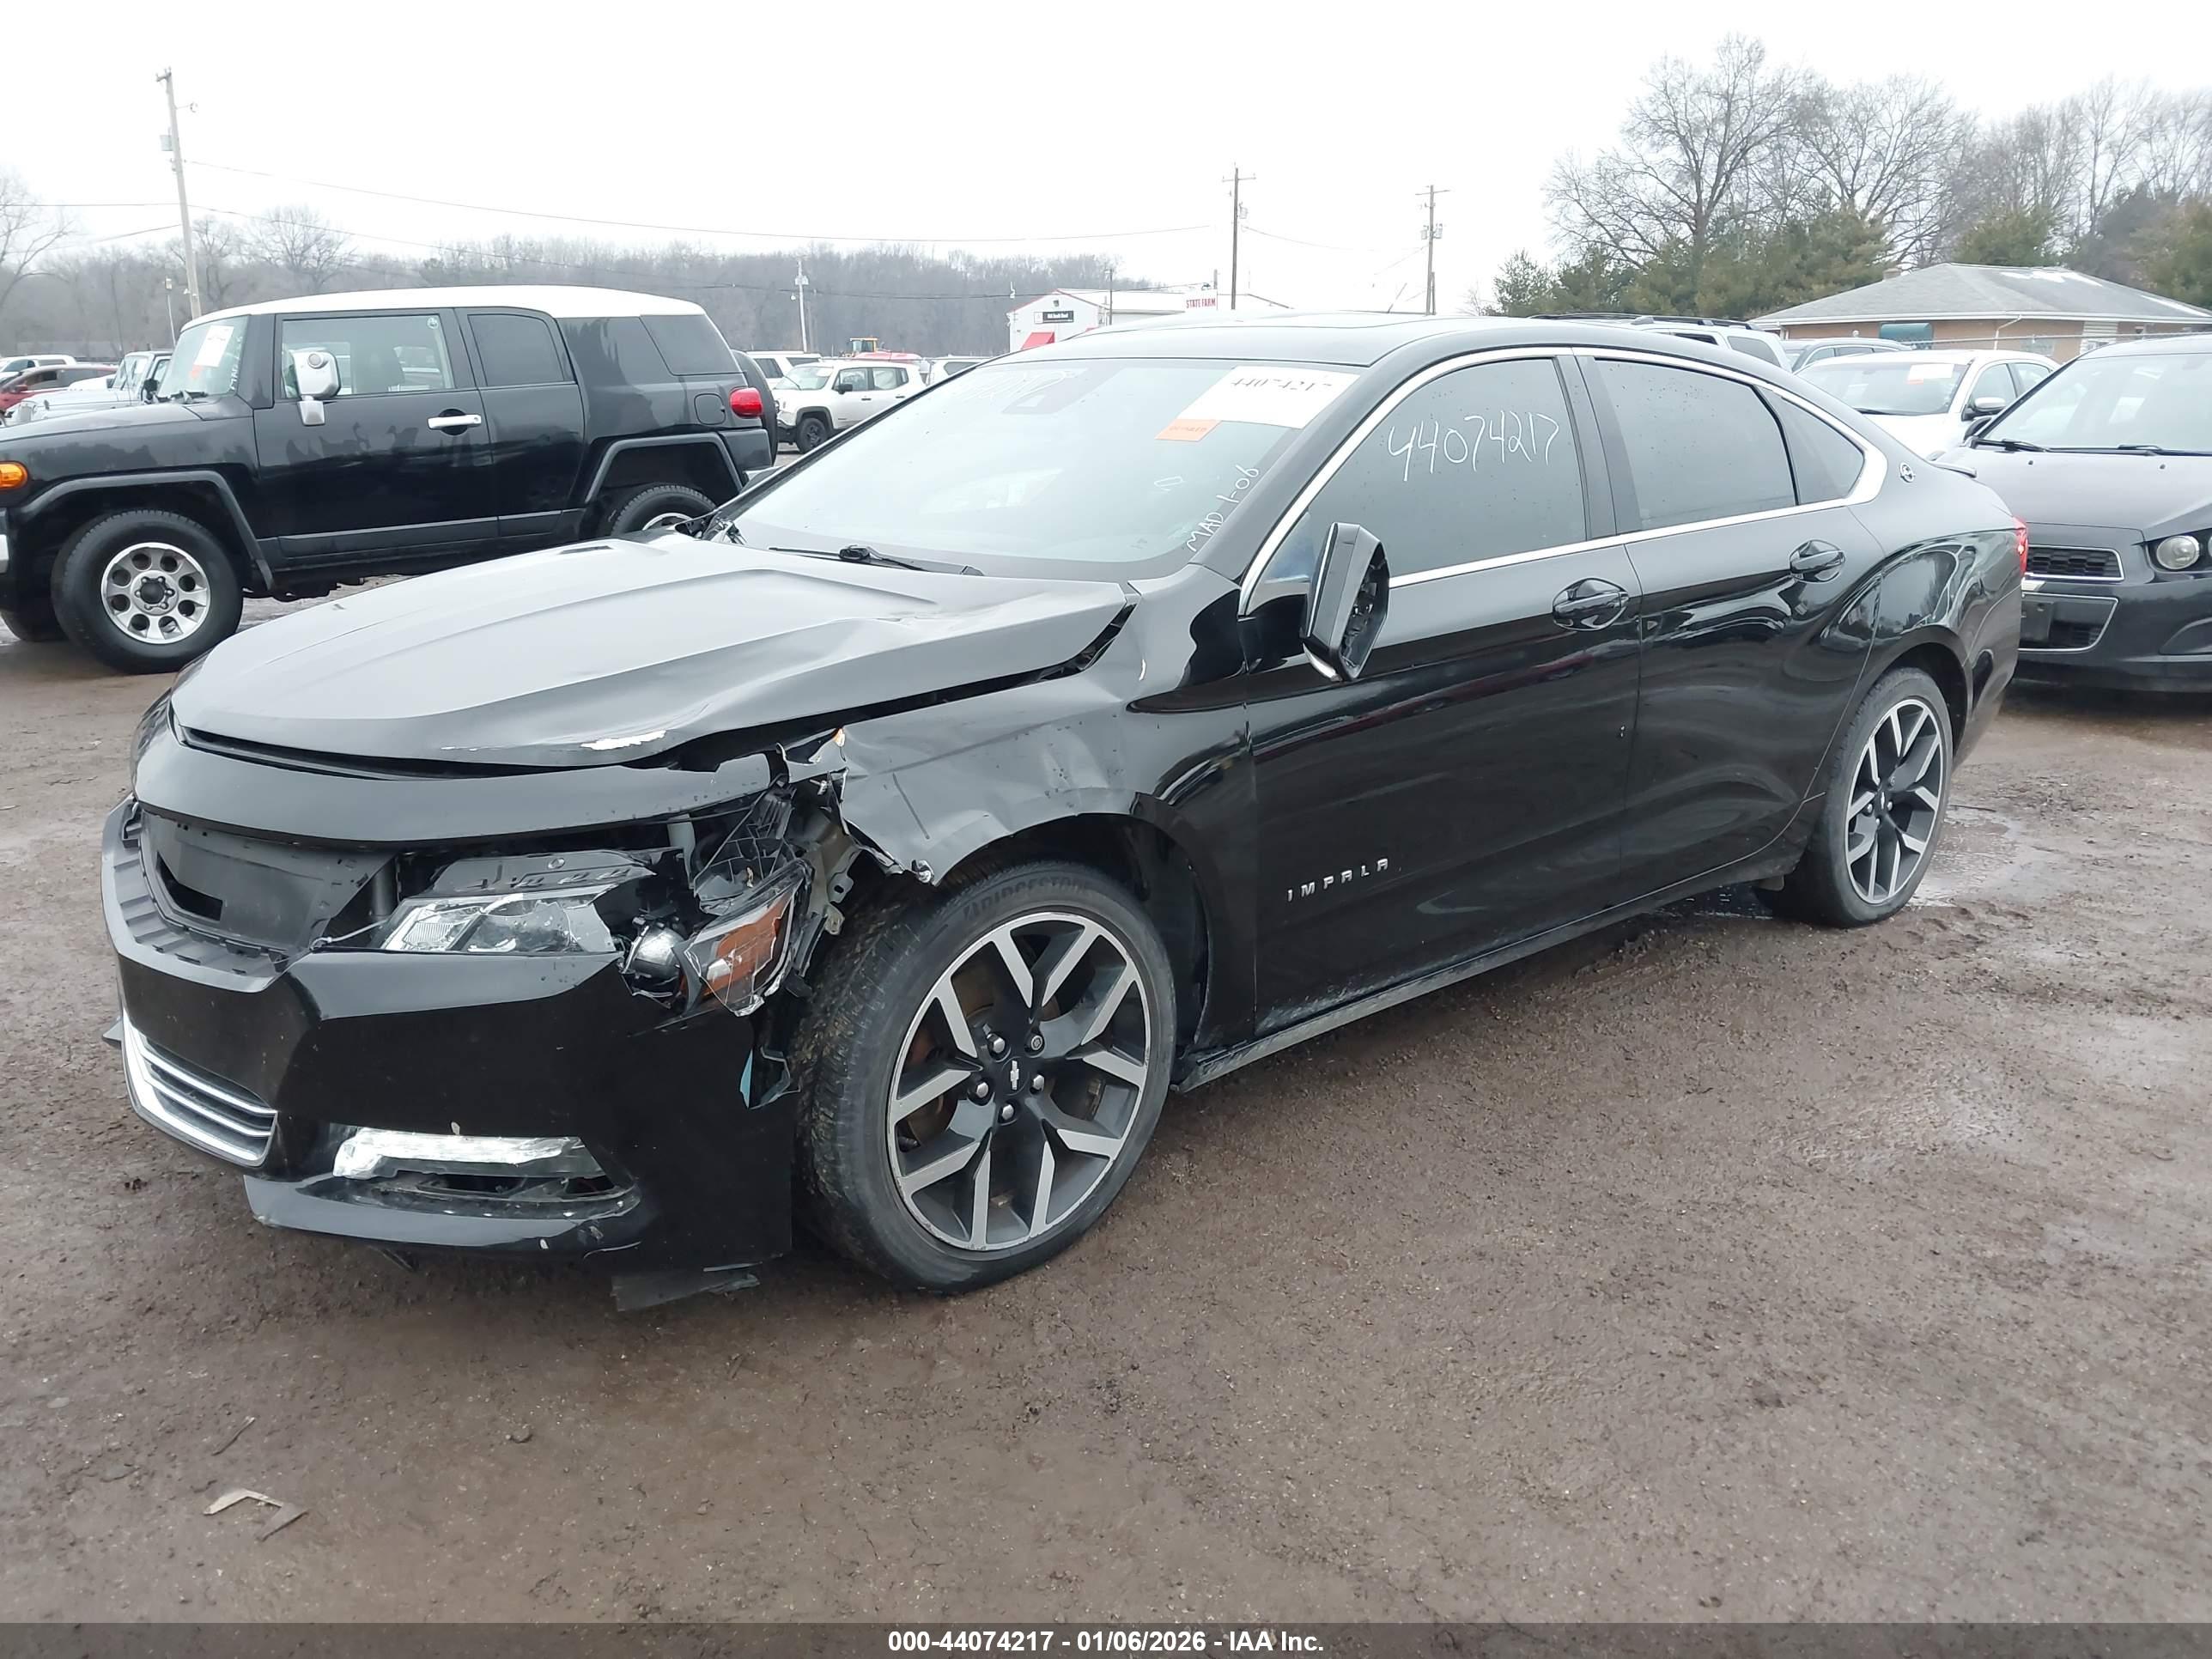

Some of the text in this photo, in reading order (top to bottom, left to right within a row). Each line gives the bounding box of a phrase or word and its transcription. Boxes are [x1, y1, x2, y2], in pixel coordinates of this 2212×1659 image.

[1186, 297, 1216, 309] STATE FARM
[1388, 410, 1559, 482] 44074217
[1186, 464, 1260, 552] MAD 1-06
[963, 875, 1089, 921] BRIDGESTON
[1287, 857, 1389, 902] IMPALA
